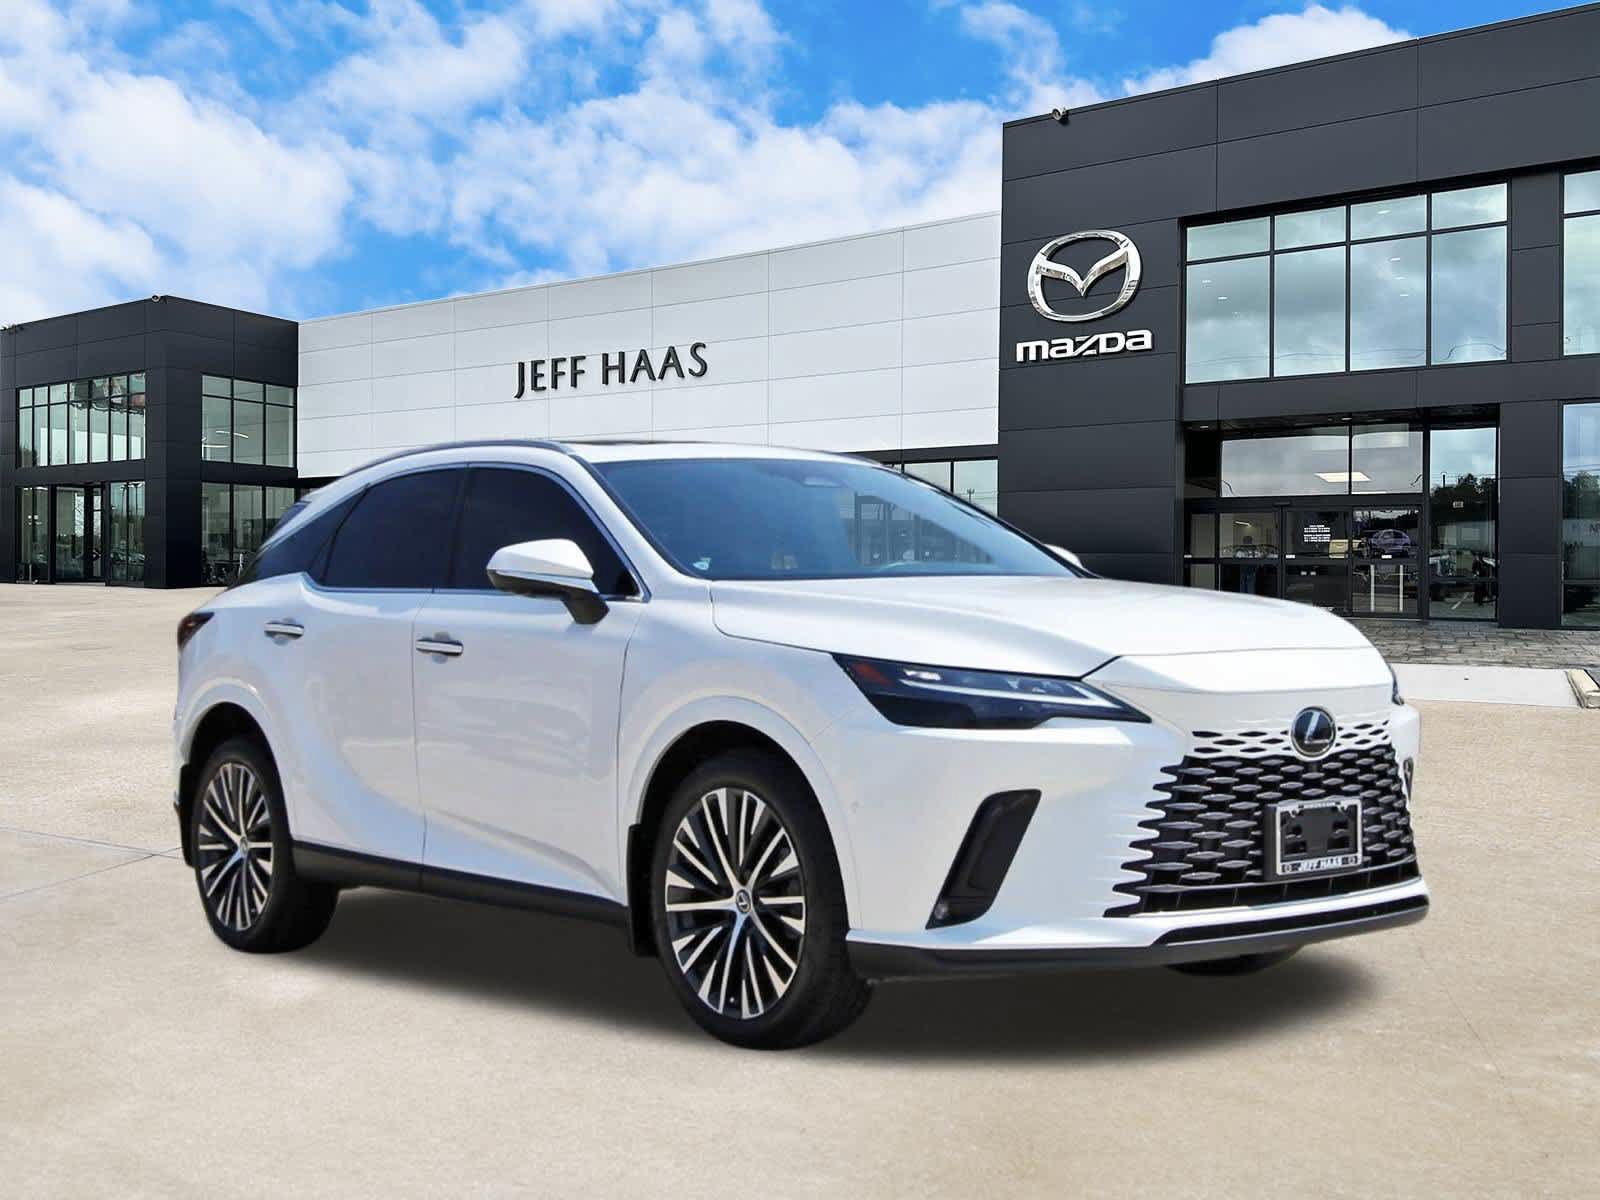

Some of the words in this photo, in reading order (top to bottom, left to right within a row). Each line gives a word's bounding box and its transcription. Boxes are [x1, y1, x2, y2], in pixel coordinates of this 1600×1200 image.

[513, 355, 587, 399] JEFF
[601, 342, 708, 386] HAAS
[1298, 859, 1320, 872] JEFF
[1319, 857, 1342, 870] HAAS
